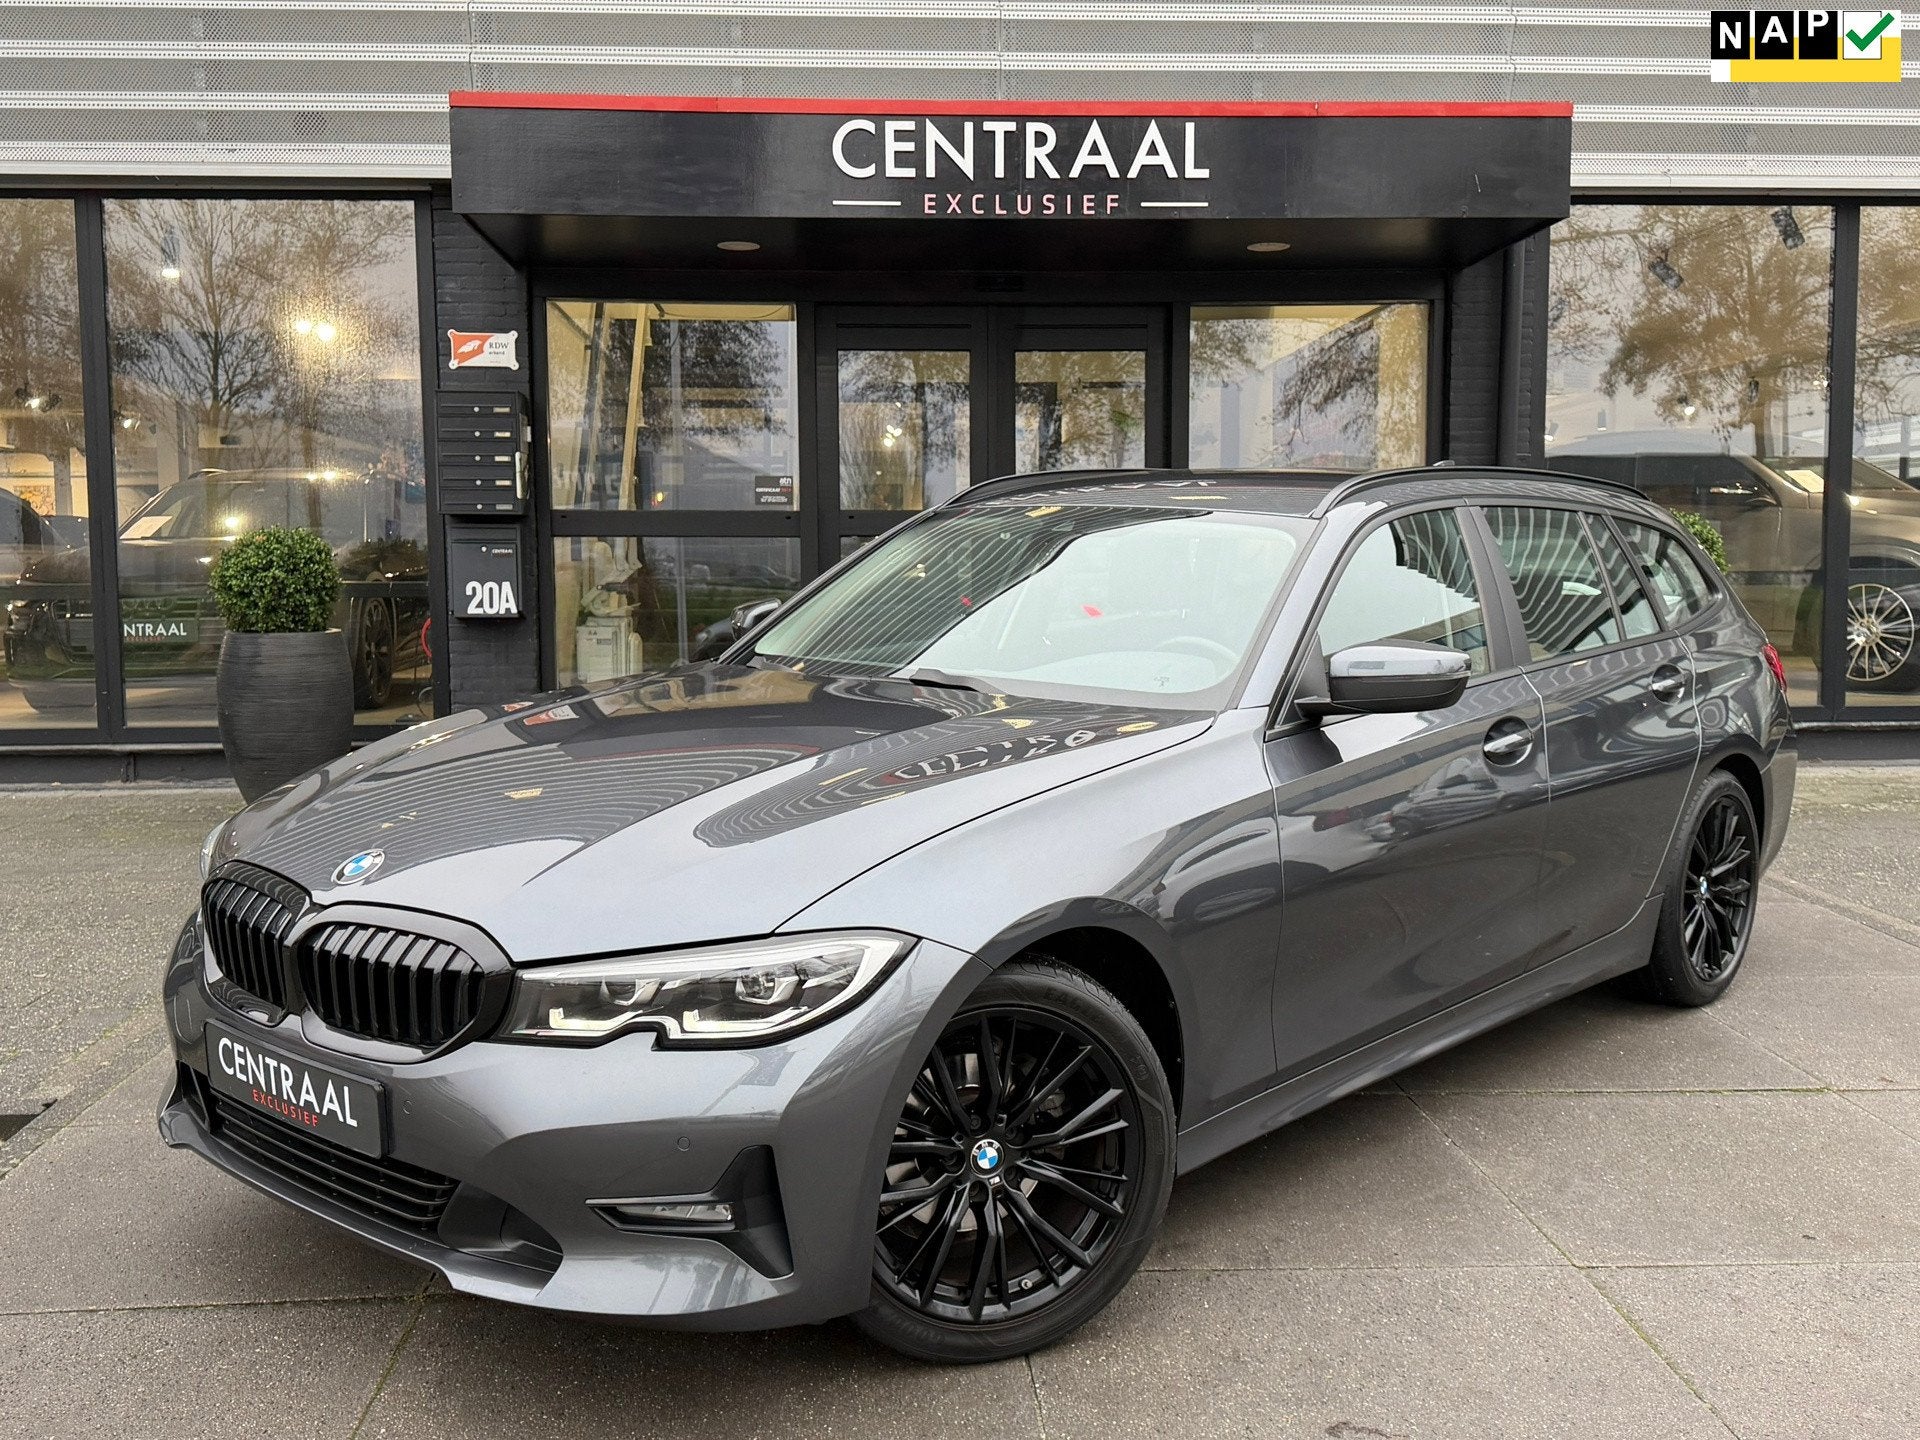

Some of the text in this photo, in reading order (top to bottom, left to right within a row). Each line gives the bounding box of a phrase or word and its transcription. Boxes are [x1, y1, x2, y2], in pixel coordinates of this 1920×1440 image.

[832, 118, 1210, 181] CENTRAAL
[924, 194, 1119, 215] EXCLUSIEF
[489, 341, 509, 349] RDW
[465, 580, 518, 614] 20A
[218, 1037, 358, 1128] CENTRAAL
[252, 1089, 319, 1127] EXCLUSIEF
